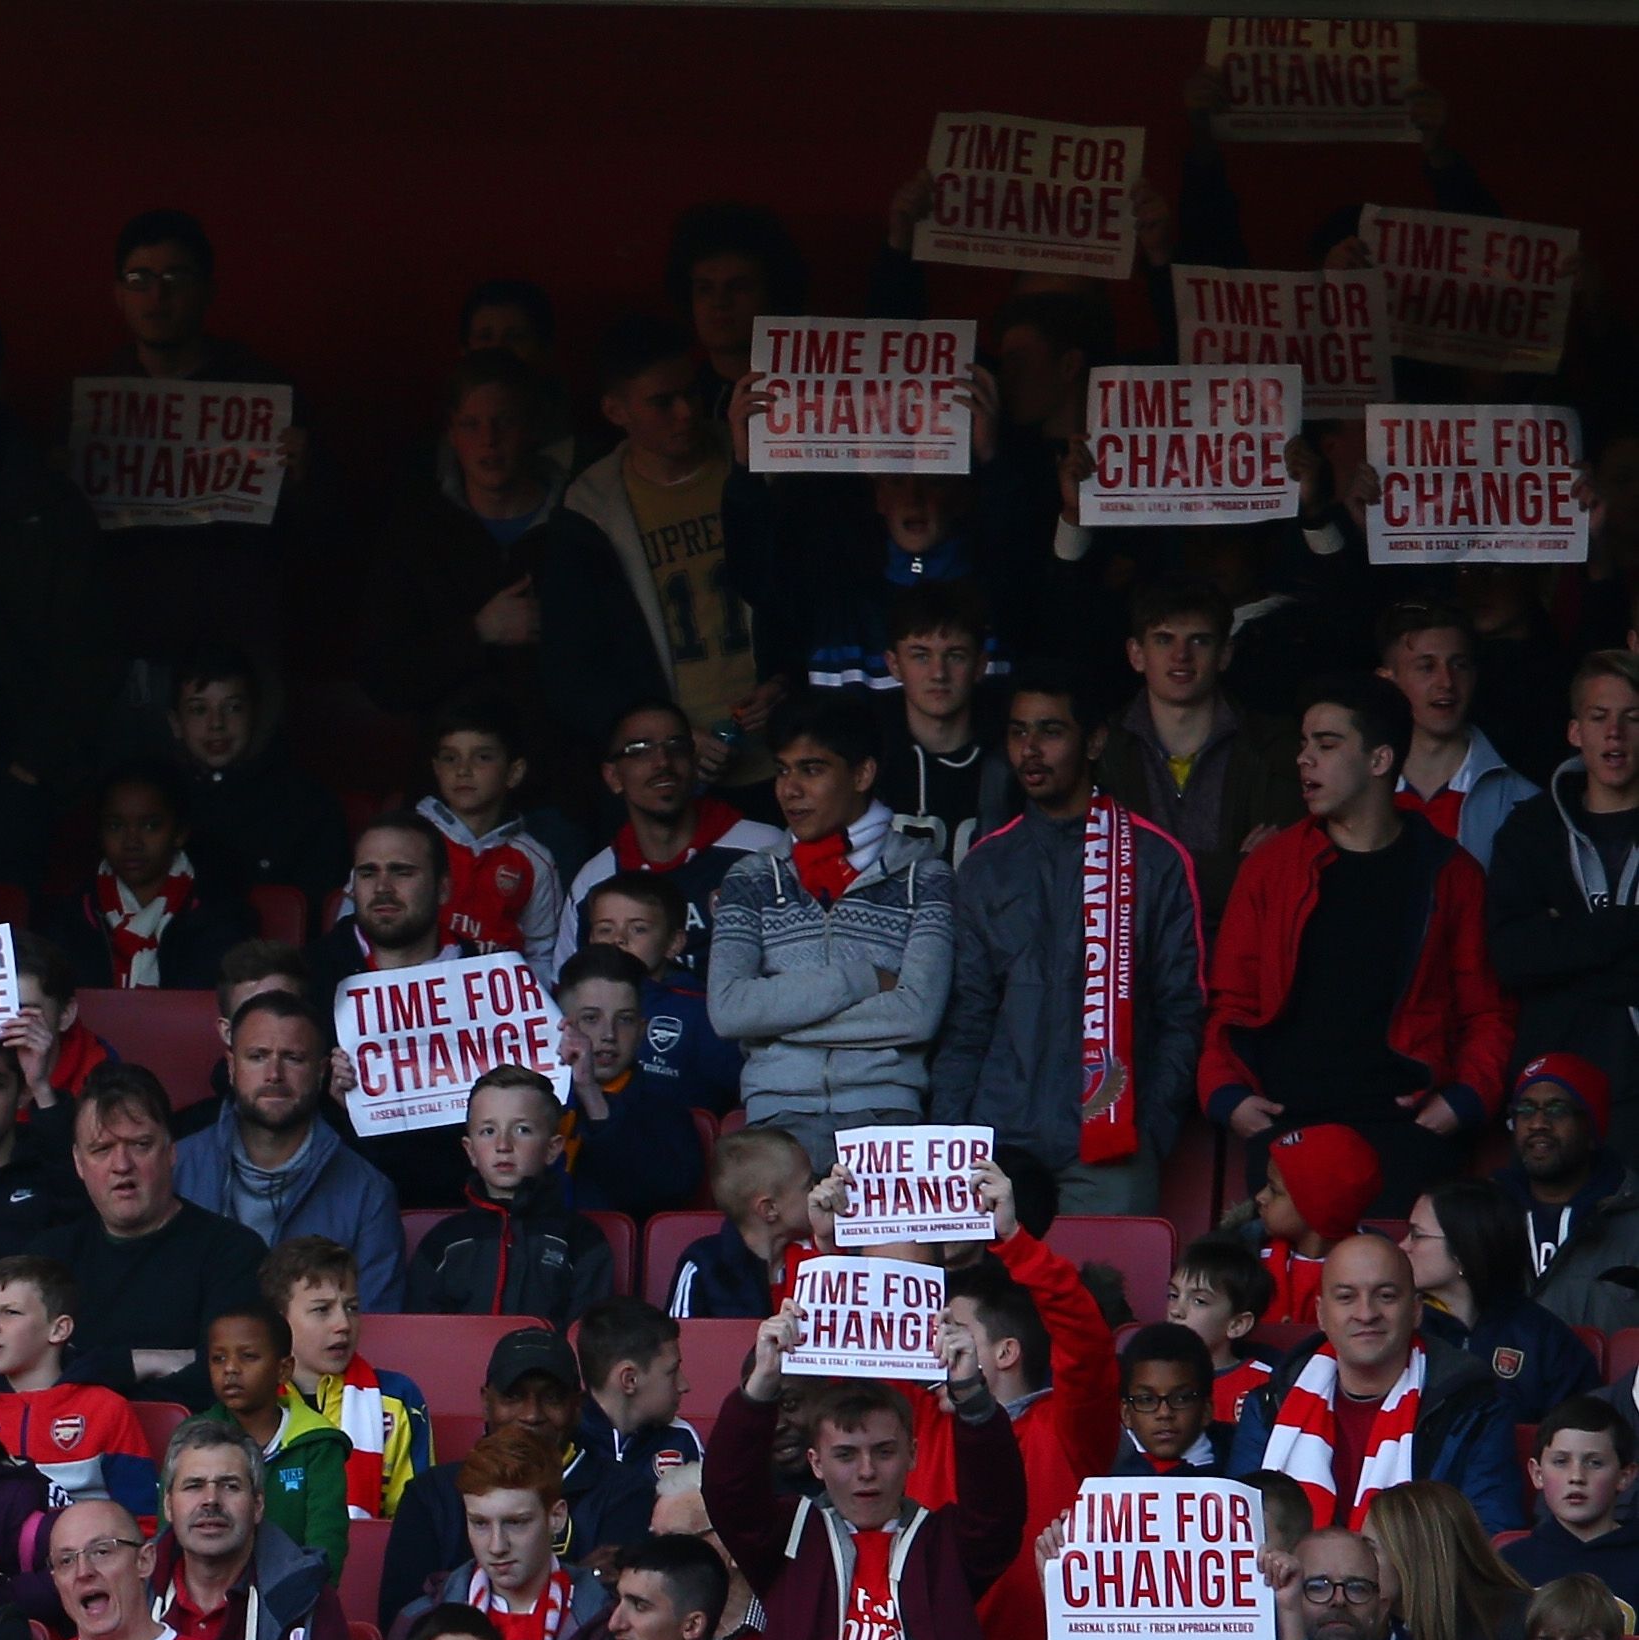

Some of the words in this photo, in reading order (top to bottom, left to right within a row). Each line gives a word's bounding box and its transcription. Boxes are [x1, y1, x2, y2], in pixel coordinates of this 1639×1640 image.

[1223, 57, 1400, 107] CHANGE
[943, 127, 1033, 179] TIME
[1054, 138, 1125, 182] FOR
[935, 179, 1123, 243] CHANGE
[1375, 219, 1469, 276] TIME
[1481, 232, 1560, 285] FOR
[1186, 278, 1282, 330] TIME
[1294, 282, 1373, 332] FOR
[770, 330, 863, 375] TIME
[881, 332, 958, 375] FOR
[93, 391, 183, 442] TIME
[200, 396, 274, 442] FOR
[763, 380, 958, 436] CHANGE
[1101, 381, 1193, 429] TIME
[1210, 379, 1284, 426] FOR
[1096, 434, 1284, 488] CHANGE
[1382, 420, 1478, 467] TIME
[1495, 420, 1570, 467] FOR
[87, 446, 269, 497] CHANGE
[1385, 473, 1576, 527] CHANGE
[1120, 873, 1132, 896] UP
[1117, 903, 1131, 1000] MARCHING
[349, 980, 450, 1038] TIME
[466, 967, 544, 1021] FOR
[359, 1015, 551, 1096] CHANGE
[841, 1142, 913, 1174] TIME
[797, 1270, 878, 1307] TIME
[883, 1275, 942, 1310] FOR
[1066, 1491, 1159, 1543] TIME
[1178, 1494, 1253, 1543] FOR
[1064, 1551, 1255, 1608] CHANGE
